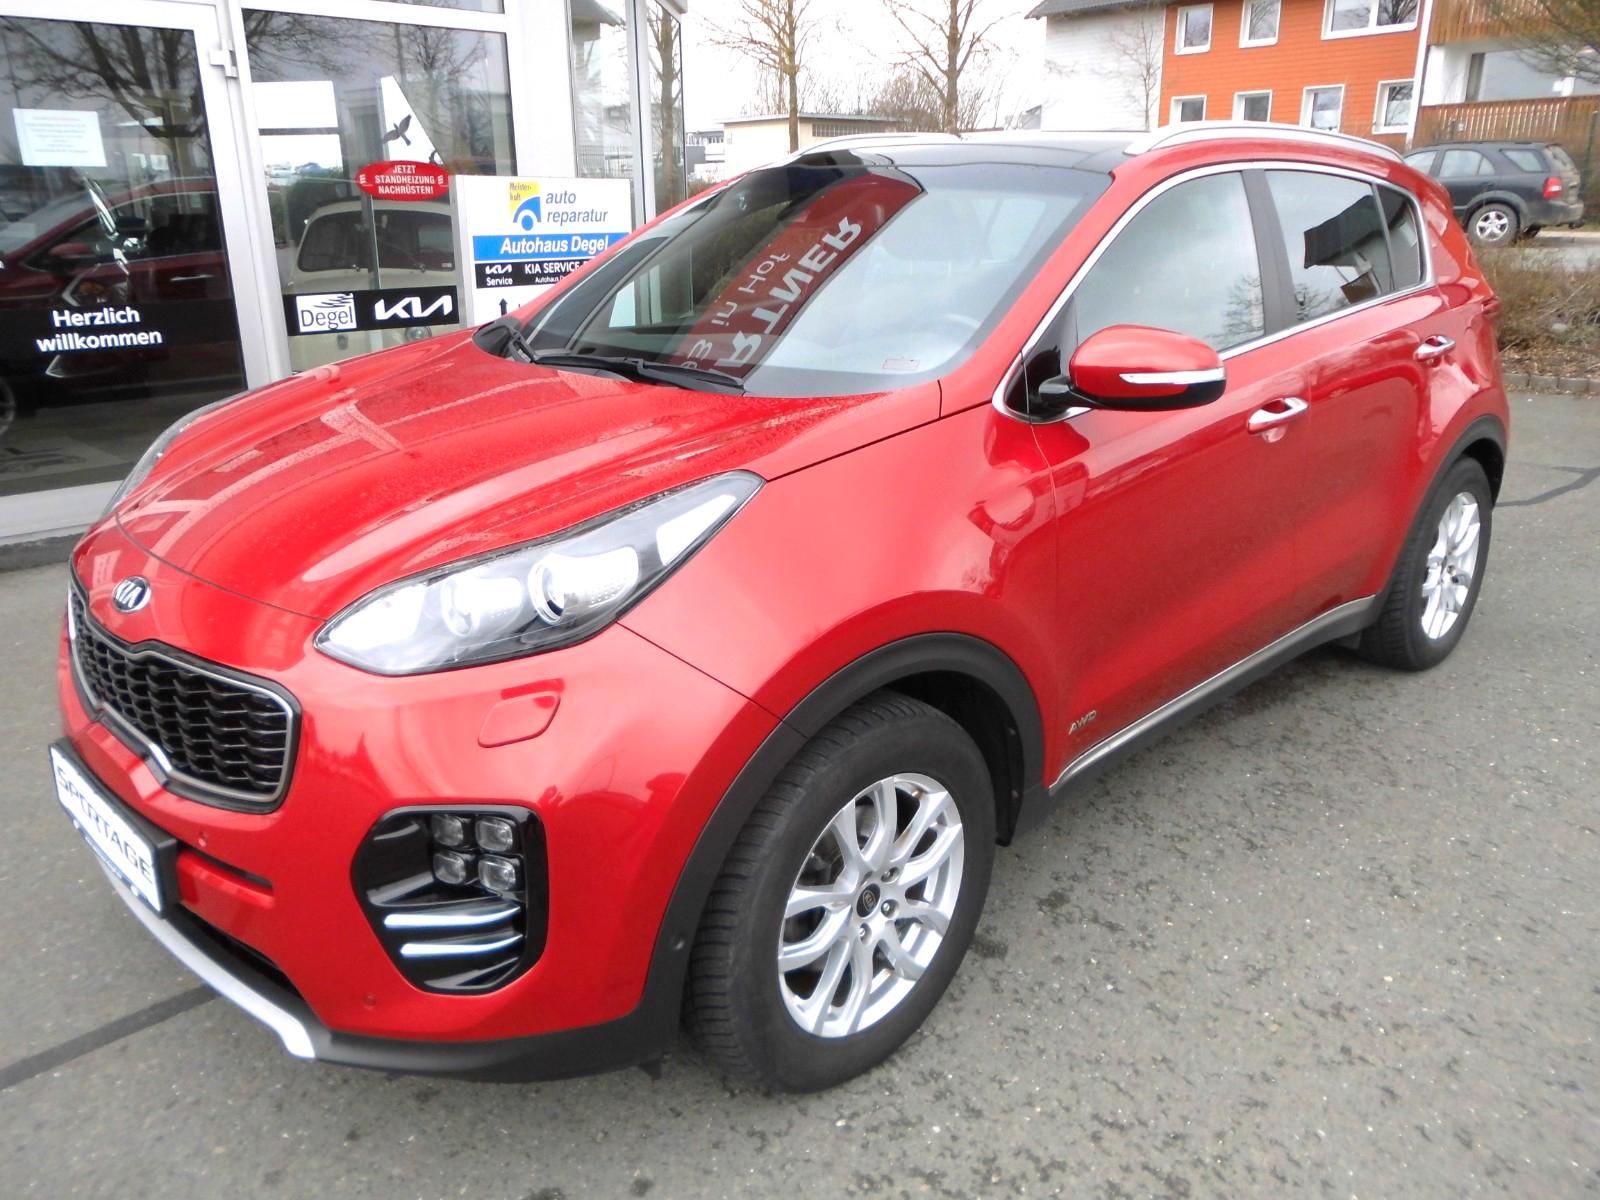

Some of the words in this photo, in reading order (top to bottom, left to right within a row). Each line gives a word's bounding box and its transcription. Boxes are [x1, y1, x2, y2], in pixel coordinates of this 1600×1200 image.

[393, 165, 416, 174] JETZT
[375, 175, 435, 184] STANDHEIZUNG
[378, 185, 434, 194] NACHRÜSTEN!
[546, 191, 577, 204] auto
[547, 210, 608, 226] reparatur
[500, 237, 568, 255] Autohaus
[571, 235, 609, 255] Degel
[525, 263, 541, 274] KIA
[486, 277, 513, 286] Service
[374, 295, 453, 321] KIA
[52, 306, 140, 327] Herzlich
[301, 306, 354, 329] Degel
[36, 331, 162, 352] willkommen
[1068, 709, 1097, 736] AWD
